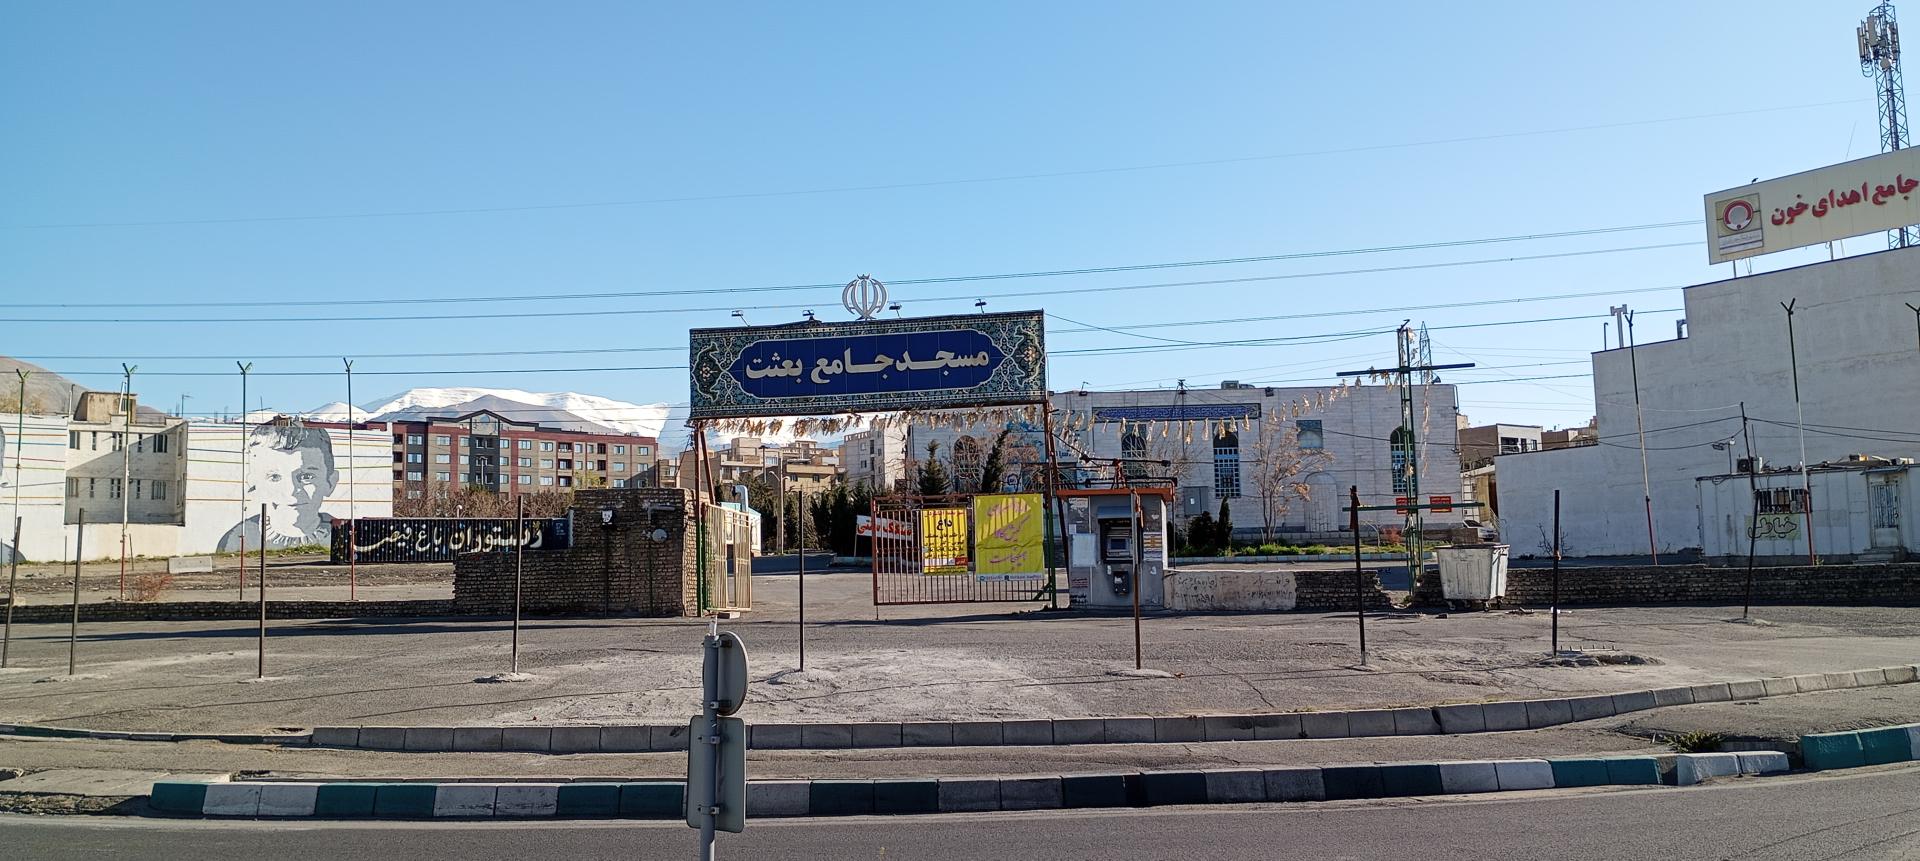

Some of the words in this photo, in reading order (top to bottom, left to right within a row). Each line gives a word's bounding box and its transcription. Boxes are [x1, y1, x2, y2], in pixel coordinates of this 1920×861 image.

[1811, 182, 1868, 218] اهدای
[1872, 174, 1920, 206] جامع
[1771, 194, 1809, 226] خون
[746, 352, 803, 384] بعثت
[811, 347, 895, 385] جامع
[896, 347, 990, 377] مسجد
[415, 523, 443, 552] باغ
[450, 524, 543, 553] رستوران
[1747, 516, 1797, 539] خیاطی
